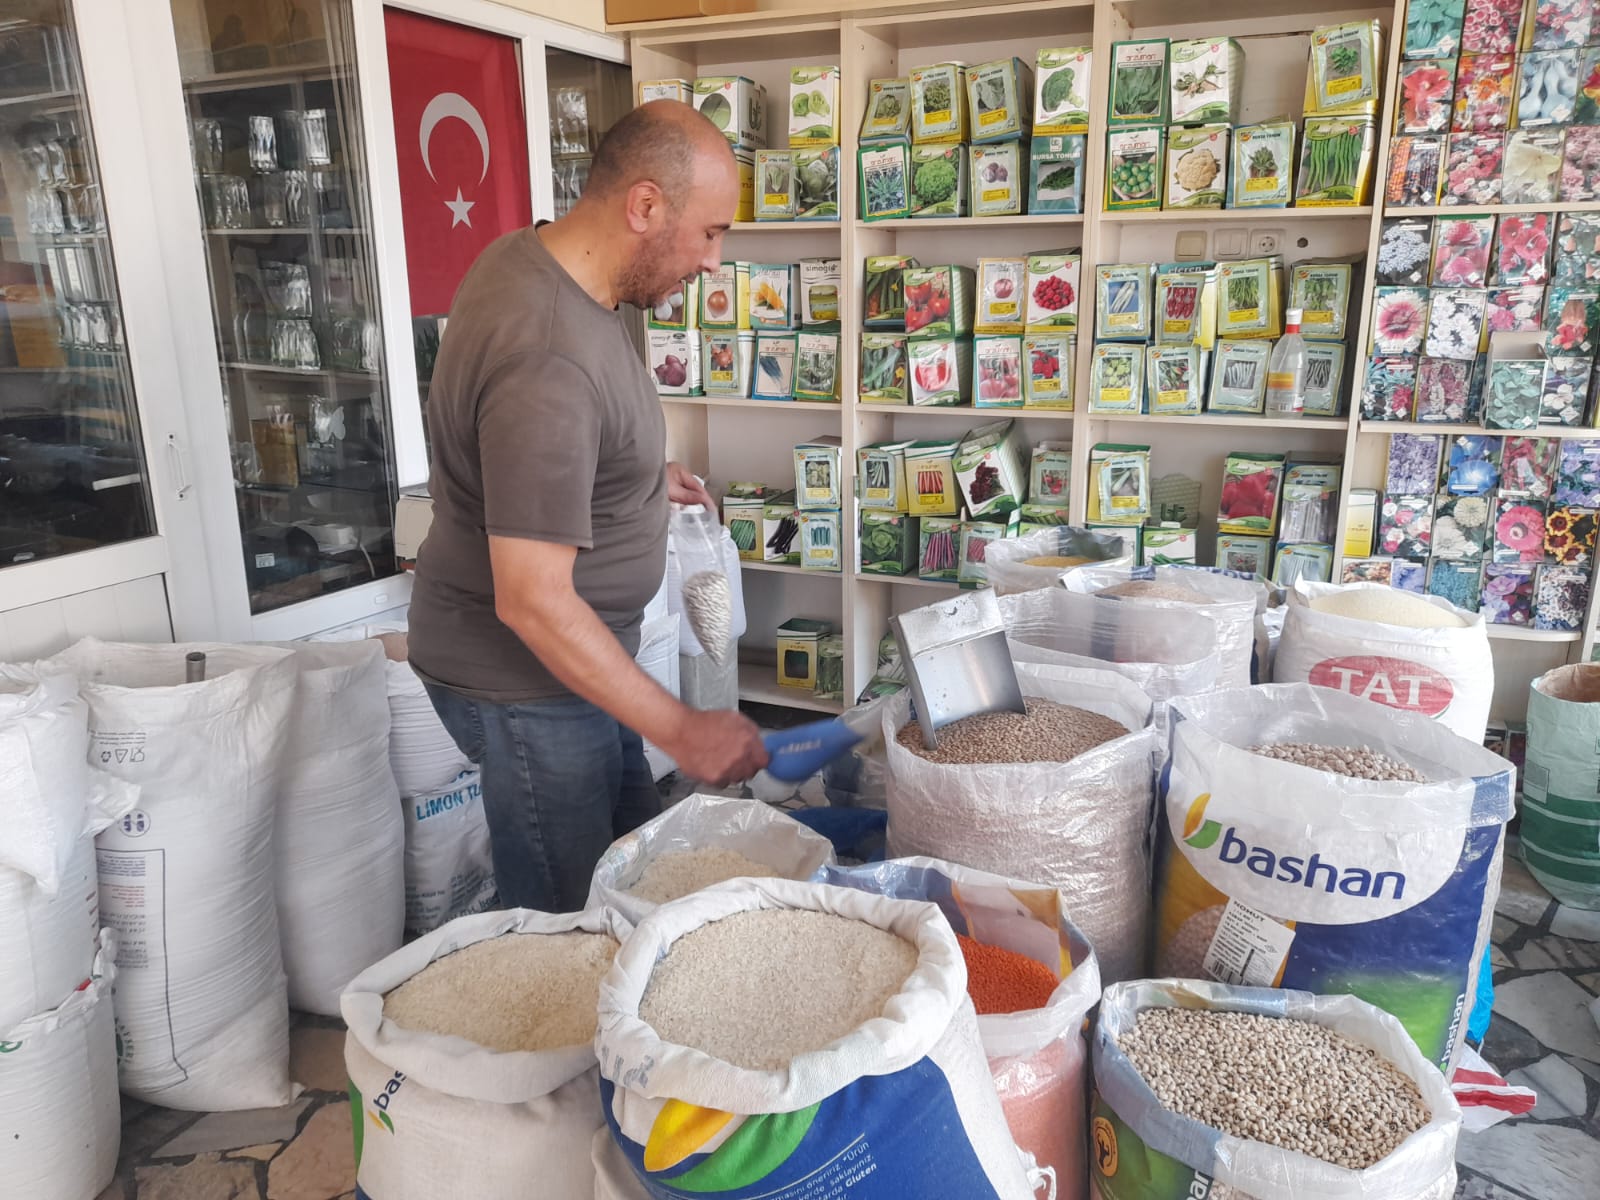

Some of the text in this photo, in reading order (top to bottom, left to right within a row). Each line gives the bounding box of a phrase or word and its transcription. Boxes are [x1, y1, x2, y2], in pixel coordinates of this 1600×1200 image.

[1032, 153, 1054, 161] BURSA
[1331, 666, 1432, 706] TAT
[466, 783, 483, 800] TU
[1218, 827, 1407, 900] bashan
[1441, 993, 1465, 1062] bashan
[845, 1163, 878, 1188] Gluten
[1186, 1169, 1210, 1200] an
